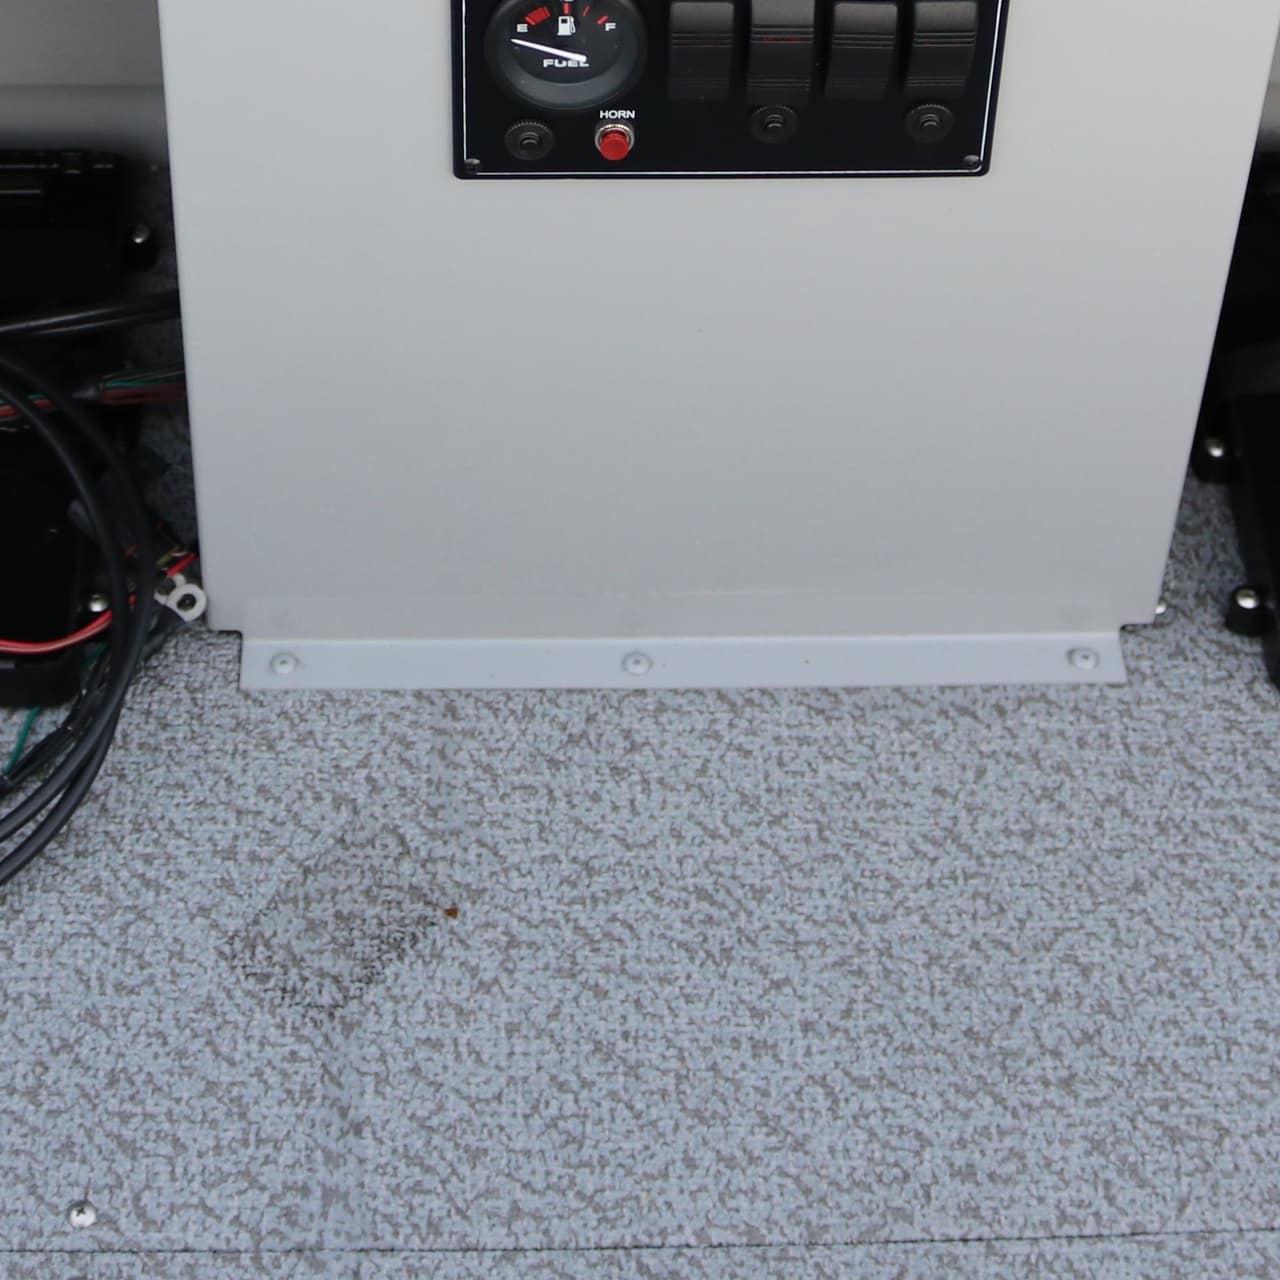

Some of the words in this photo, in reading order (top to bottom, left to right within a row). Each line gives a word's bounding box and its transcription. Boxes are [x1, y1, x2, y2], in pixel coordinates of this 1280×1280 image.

[517, 23, 528, 32] E
[605, 22, 616, 32] F
[543, 58, 589, 68] FUEL
[599, 110, 636, 119] HORN
